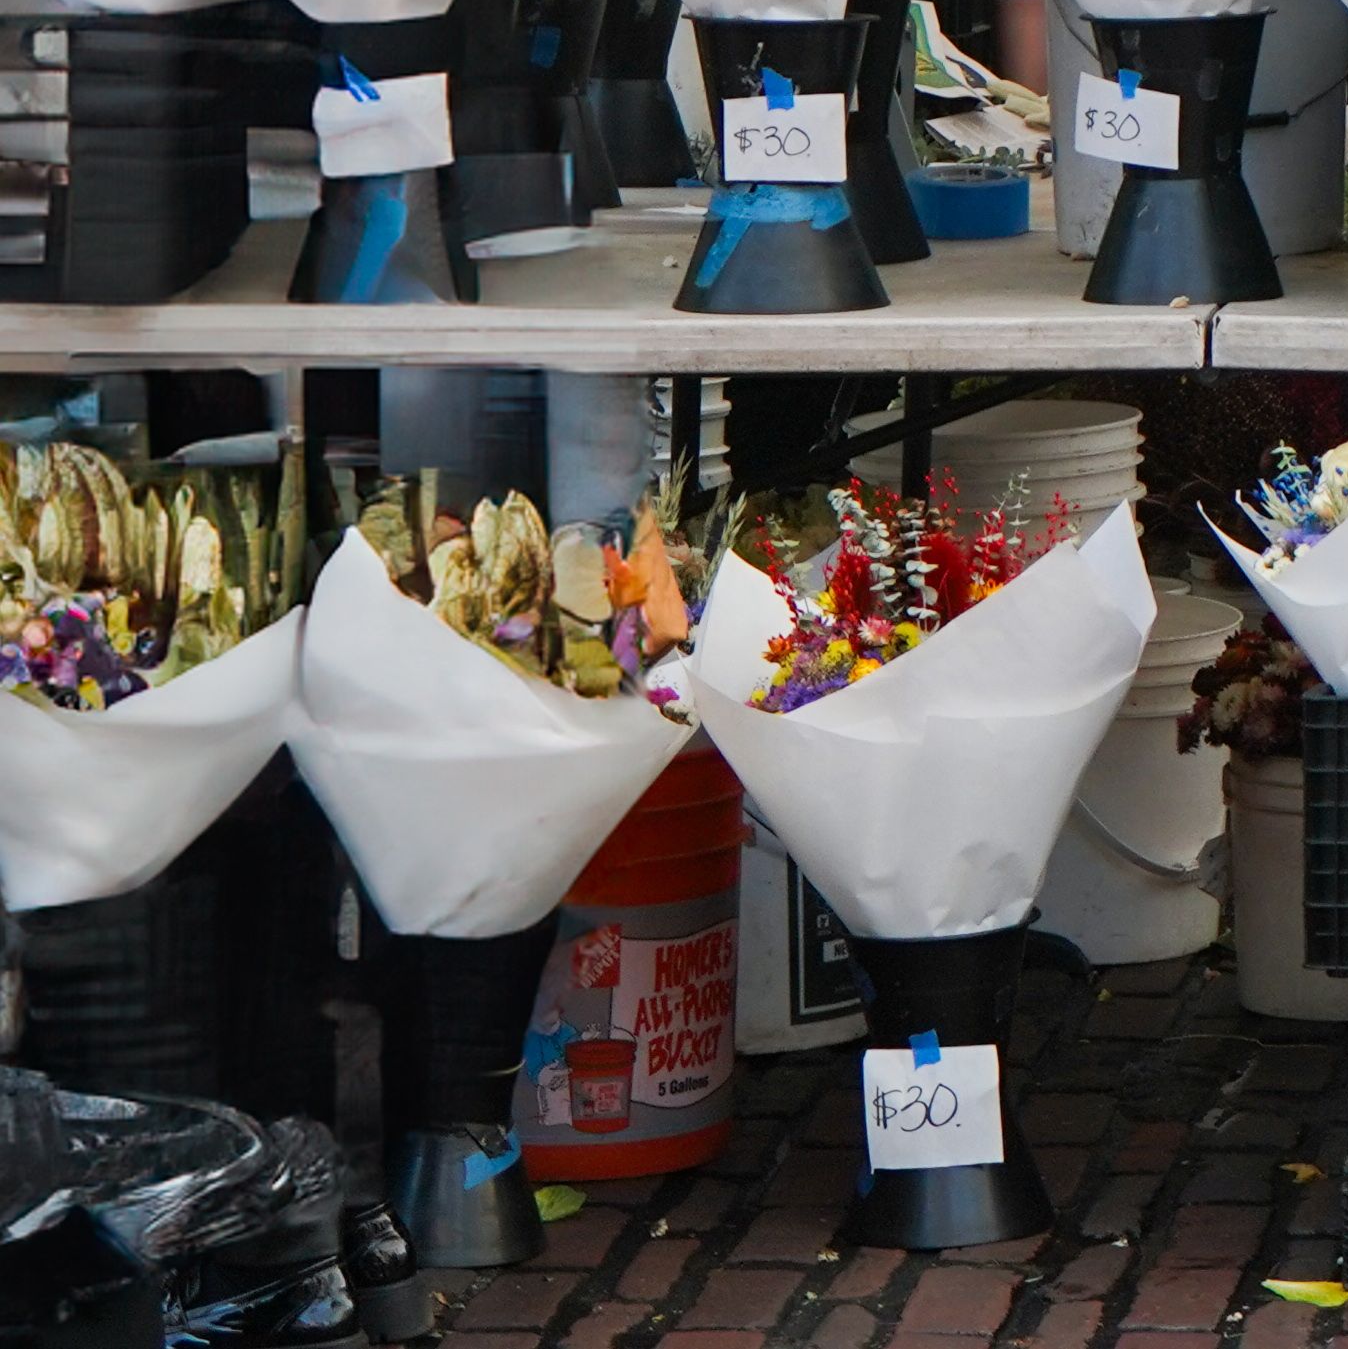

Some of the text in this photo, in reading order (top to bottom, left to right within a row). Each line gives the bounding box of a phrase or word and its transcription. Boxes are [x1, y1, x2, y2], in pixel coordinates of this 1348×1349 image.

[648, 1023, 723, 1077] BUCKET
[658, 1075, 710, 1097] 5 Gallons
